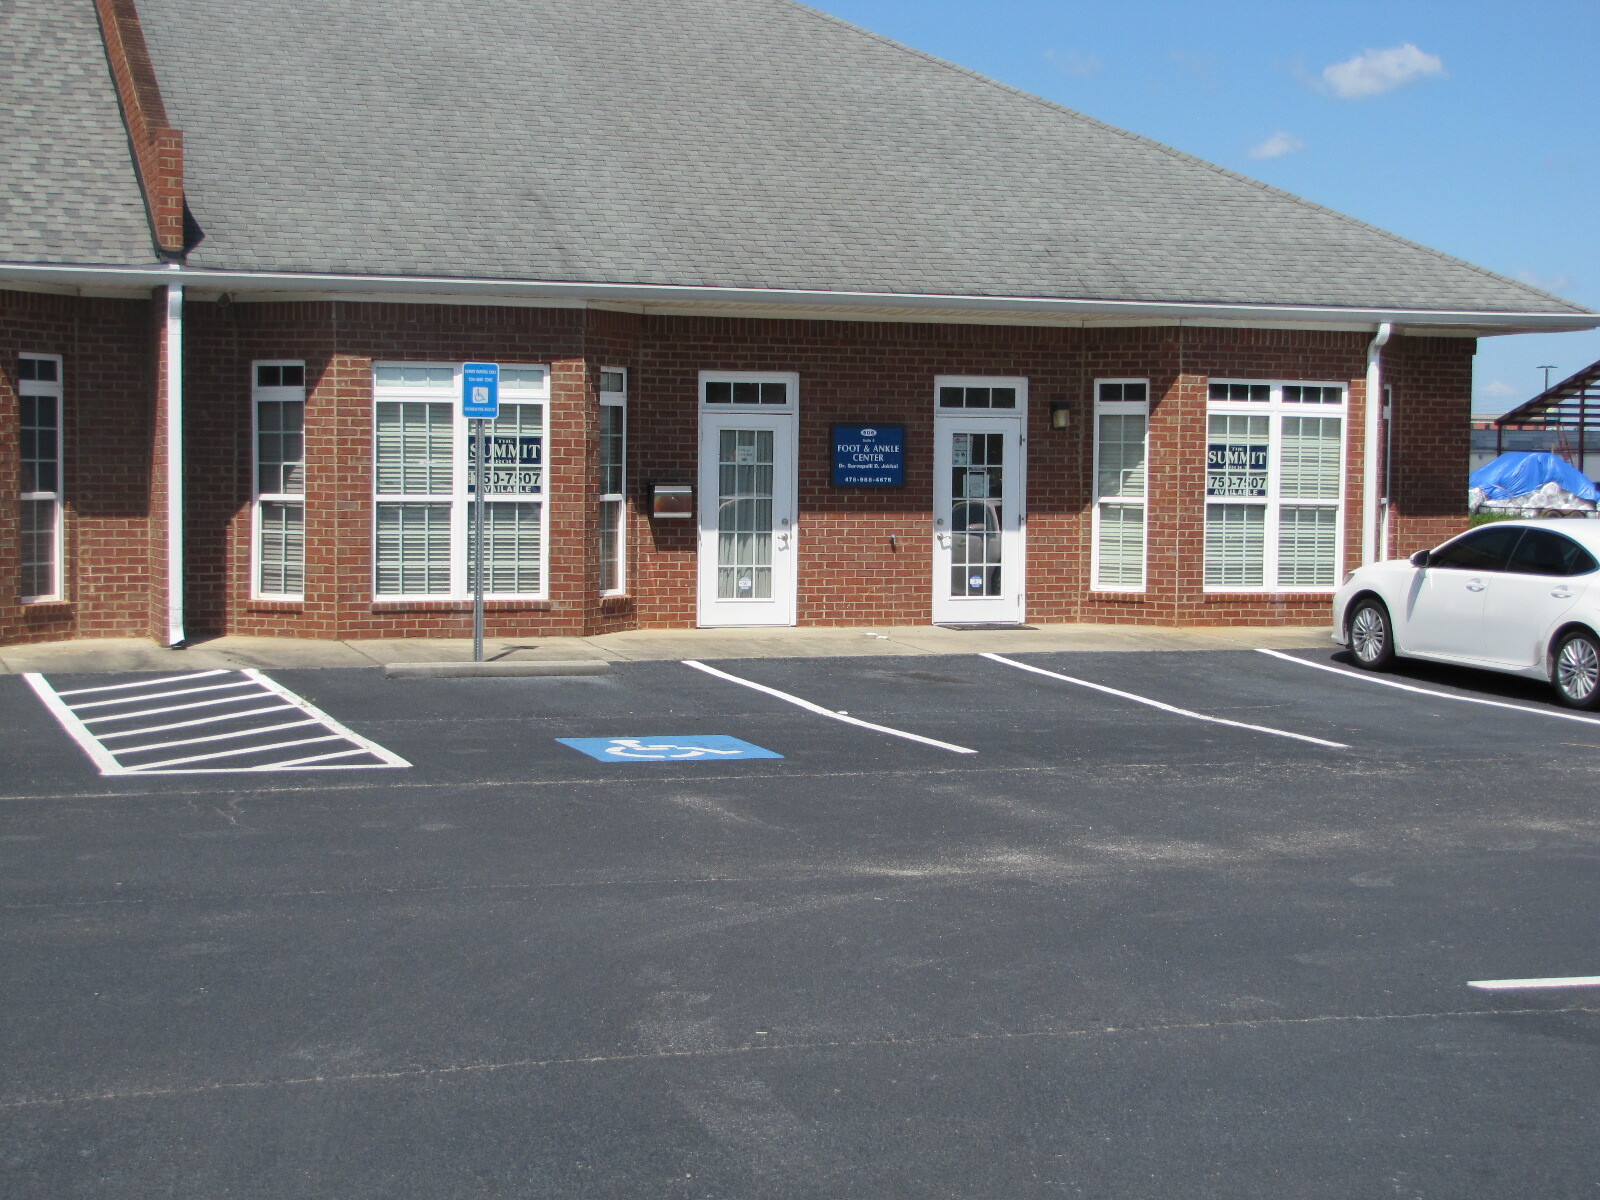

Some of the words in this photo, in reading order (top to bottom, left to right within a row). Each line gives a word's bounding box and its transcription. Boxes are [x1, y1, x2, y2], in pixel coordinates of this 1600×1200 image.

[469, 444, 541, 458] SUMMIT
[837, 444, 860, 452] FOOT
[863, 444, 870, 452] &
[873, 444, 899, 452] ANKLE
[853, 453, 884, 461] CENTER
[1208, 450, 1266, 464] SUMMIT
[474, 472, 541, 484] 50-7507
[1211, 477, 1266, 488] 750-7507
